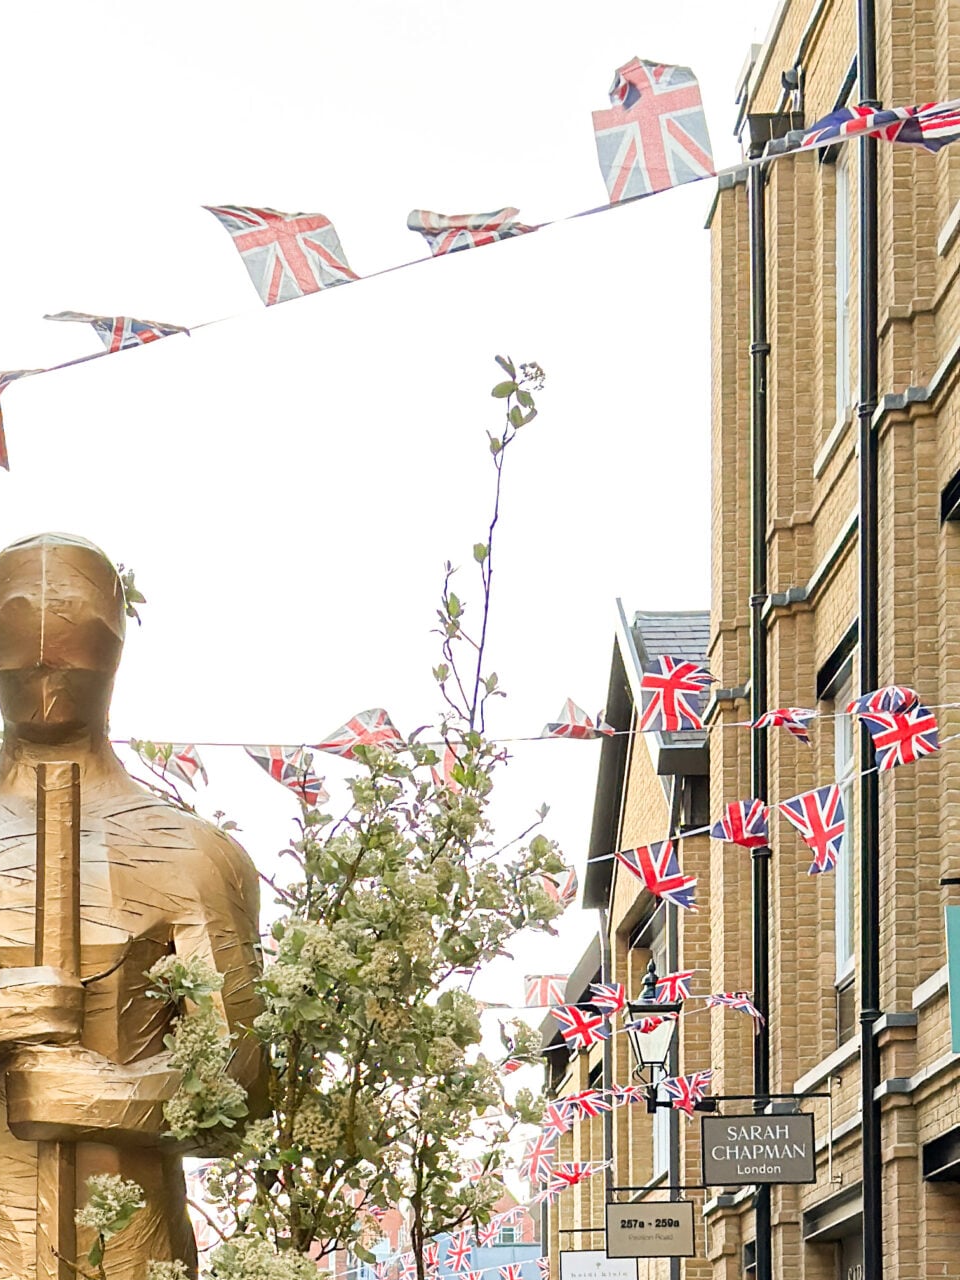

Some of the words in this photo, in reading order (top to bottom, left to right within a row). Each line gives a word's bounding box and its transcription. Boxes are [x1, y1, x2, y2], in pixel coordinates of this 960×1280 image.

[727, 1125, 789, 1141] SARAH
[711, 1143, 806, 1161] CHAPMAN
[737, 1164, 781, 1175] London
[620, 1219, 645, 1229] 257a
[655, 1218, 680, 1228] 259a
